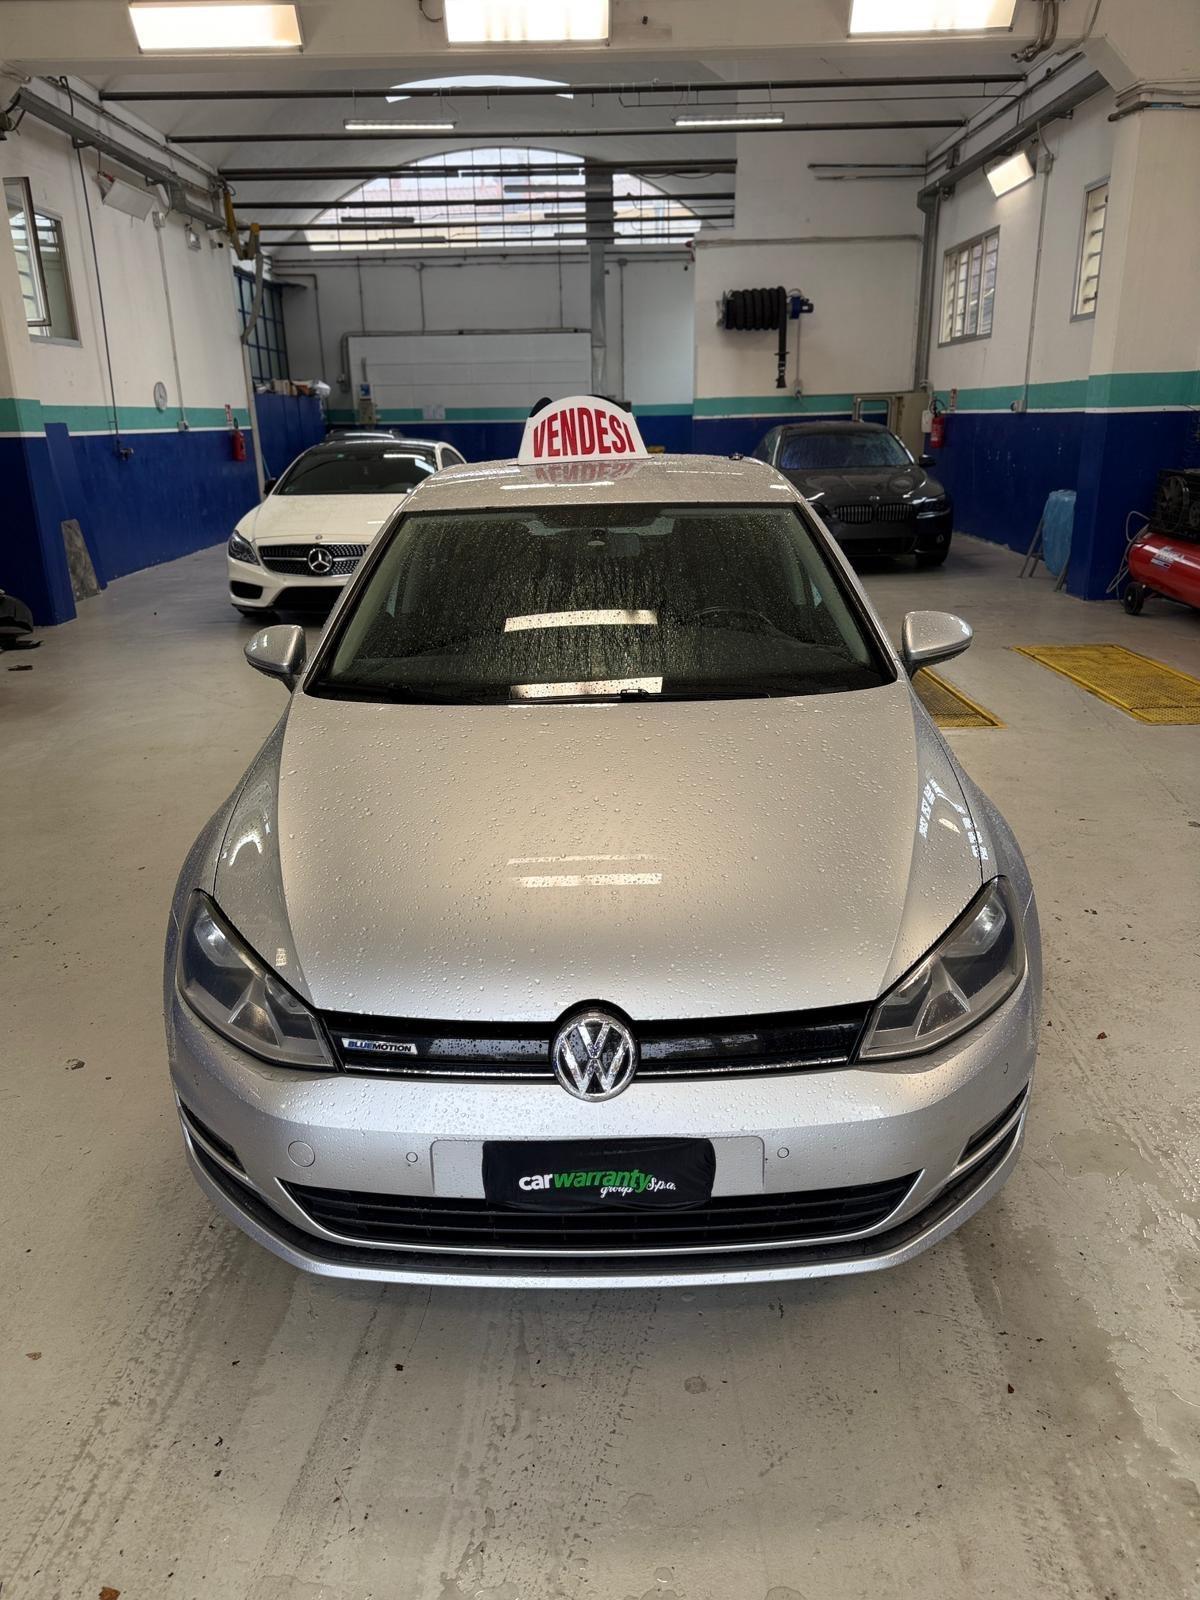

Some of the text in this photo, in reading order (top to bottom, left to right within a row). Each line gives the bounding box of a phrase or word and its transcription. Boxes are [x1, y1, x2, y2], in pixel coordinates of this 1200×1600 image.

[533, 407, 636, 458] VENDESI
[347, 1040, 412, 1052] BLUEMOTION
[600, 1186, 634, 1198] group
